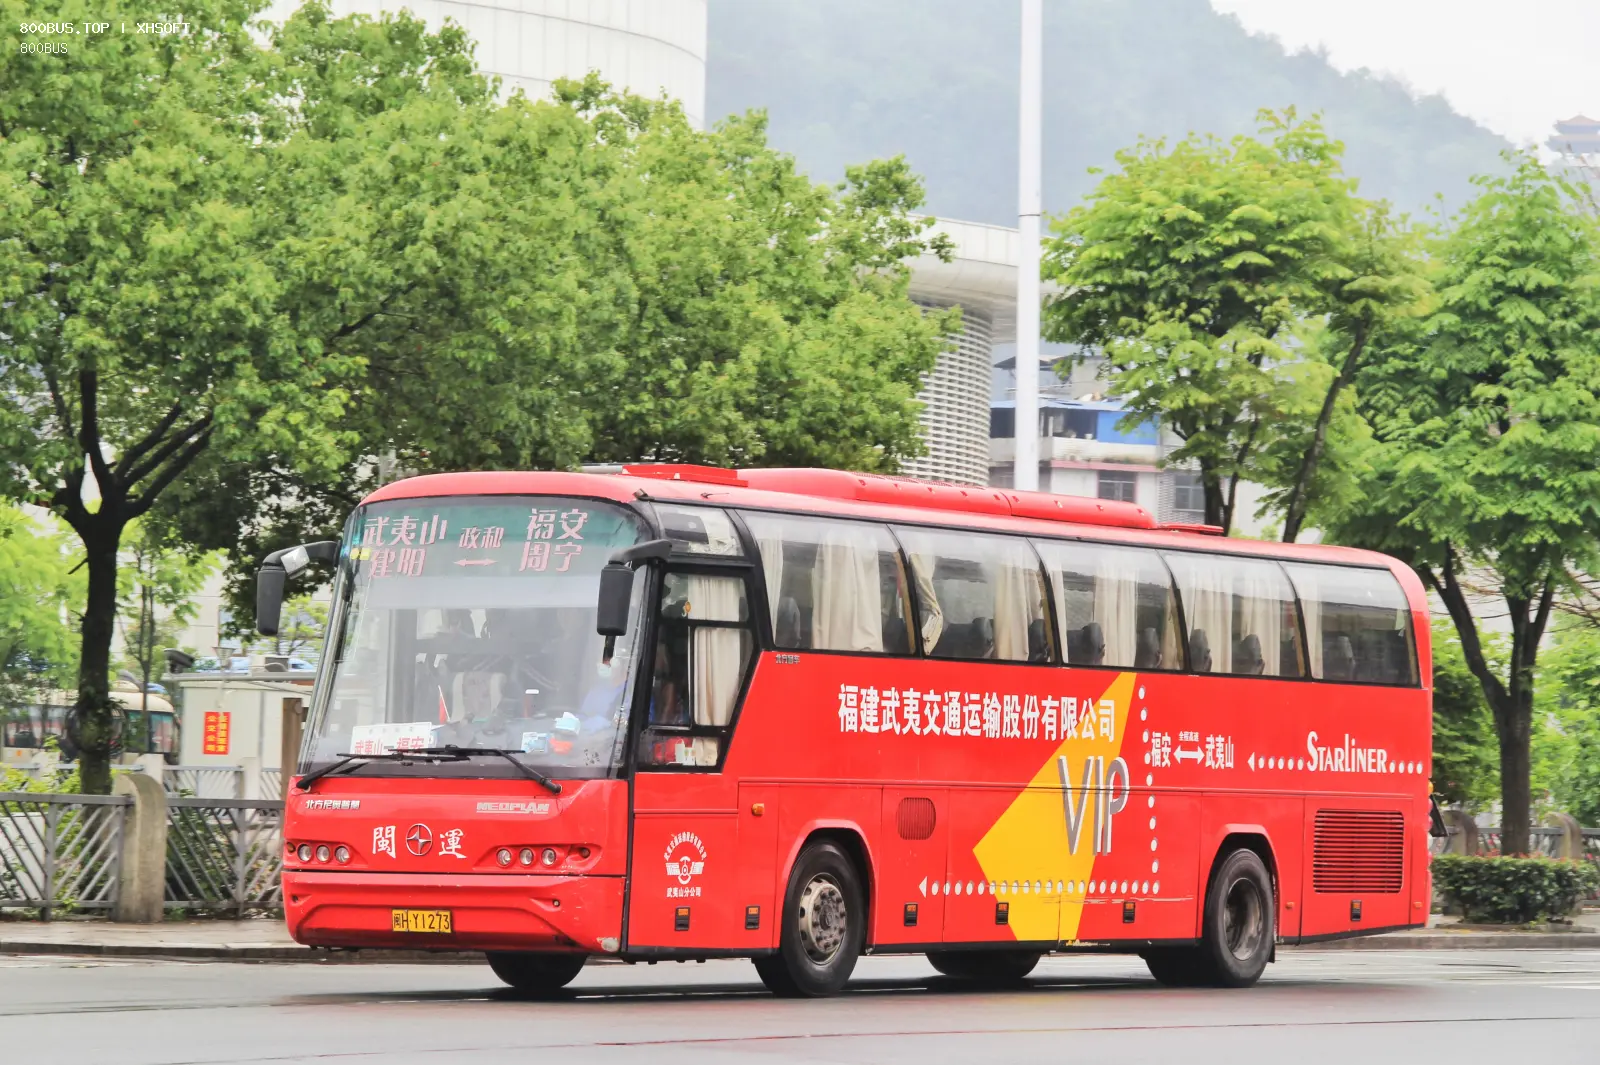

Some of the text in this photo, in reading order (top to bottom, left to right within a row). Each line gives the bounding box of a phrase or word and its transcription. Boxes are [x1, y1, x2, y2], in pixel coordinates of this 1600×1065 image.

[458, 525, 504, 549] 政和
[526, 508, 588, 540] 福安
[519, 541, 583, 572] 周宁
[838, 683, 1115, 742] 福建武夷交通运输股份有限公司
[1151, 731, 1234, 769] 福安 武夷山
[476, 801, 550, 815] NEOPLAN
[1057, 755, 1131, 857] VIP
